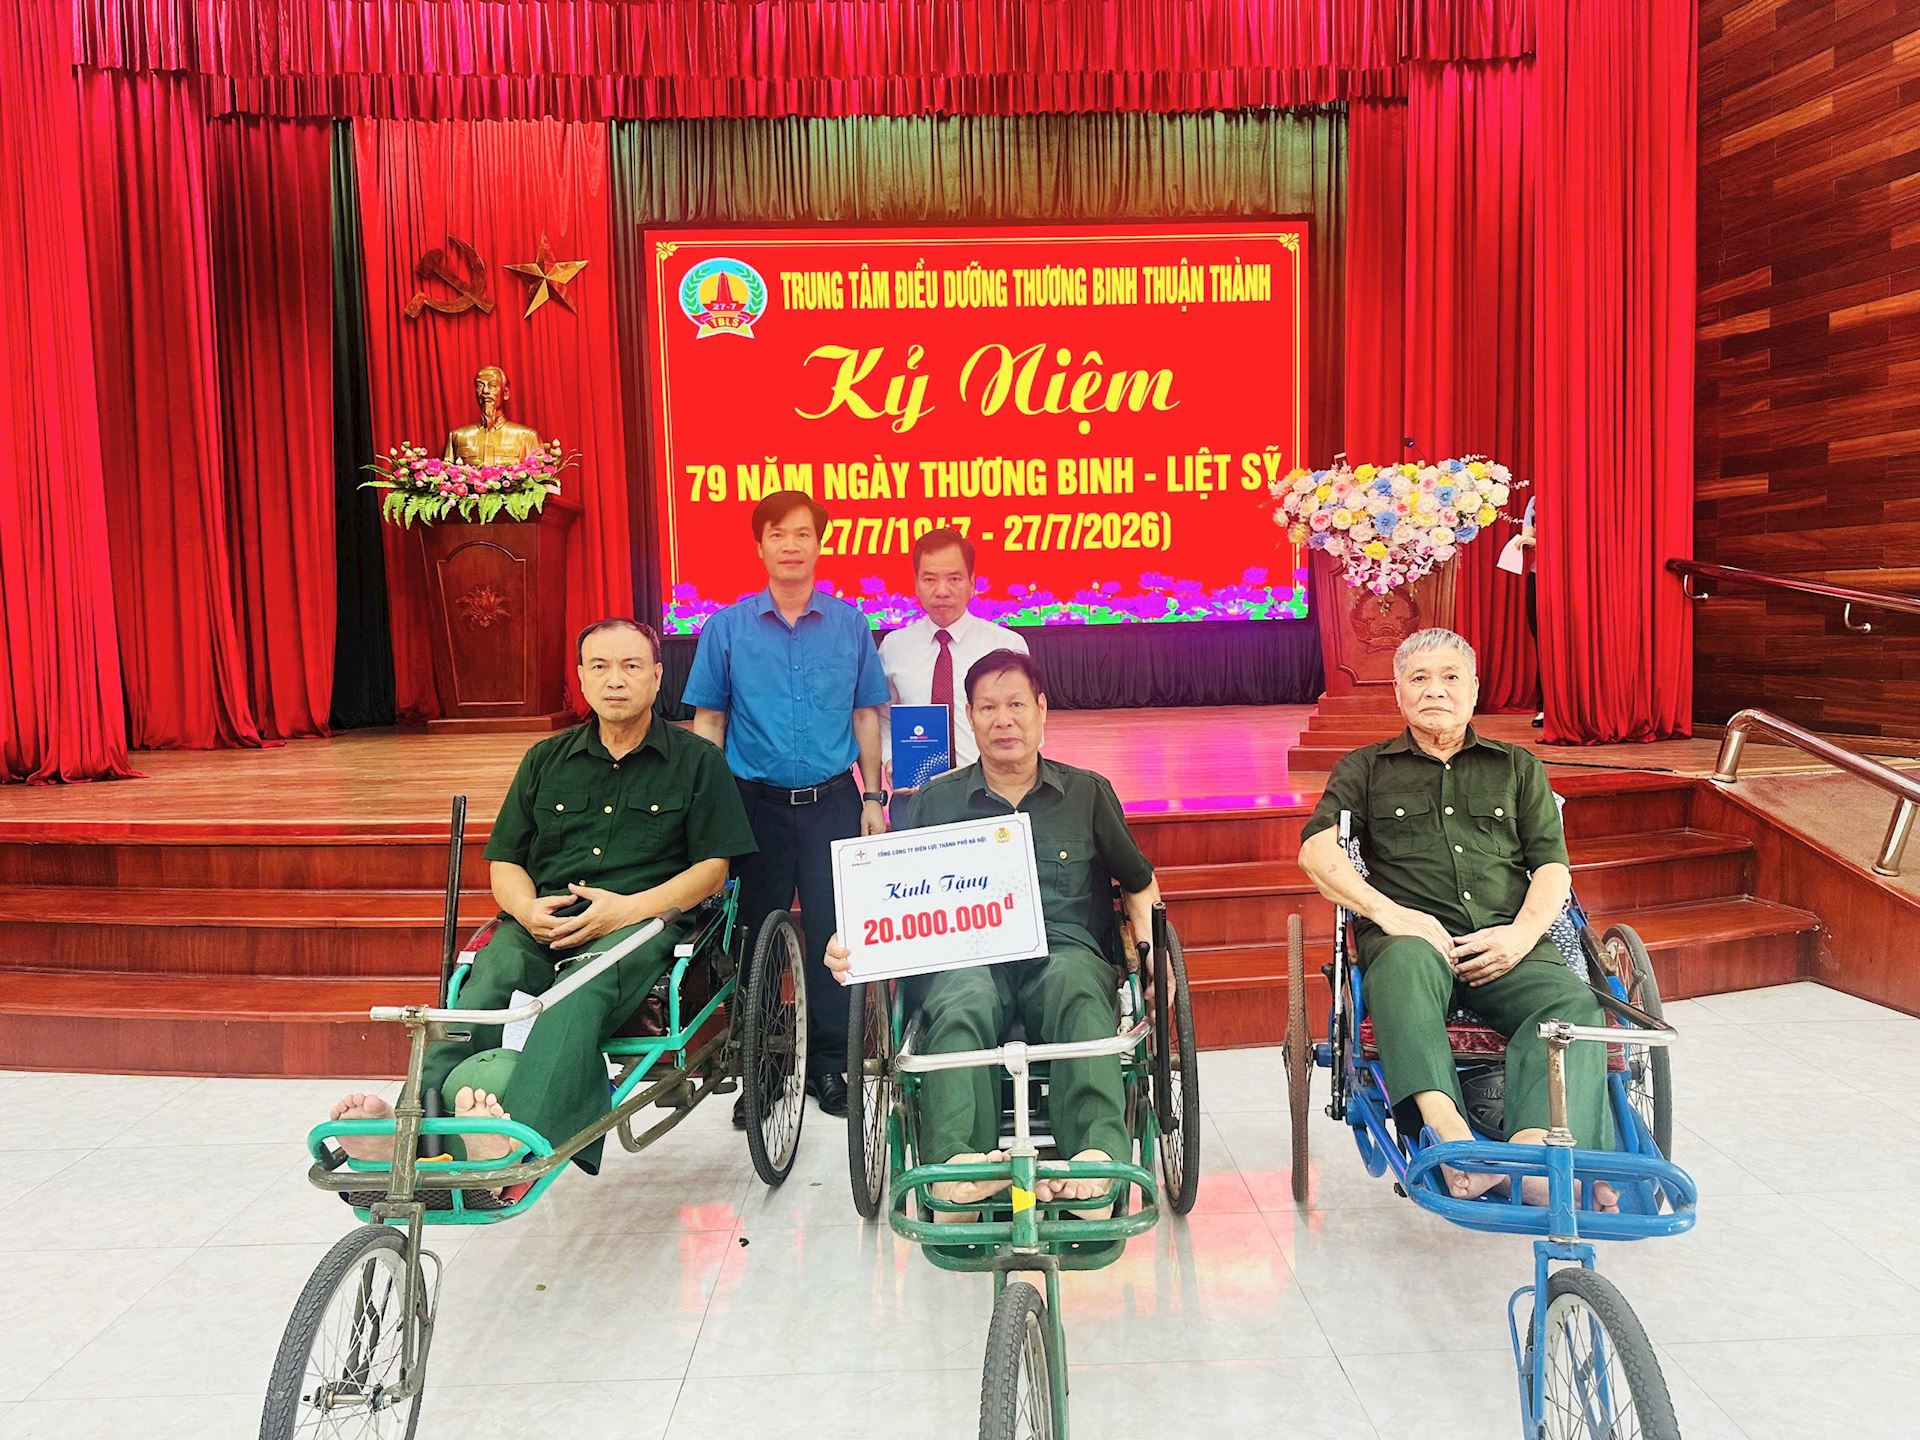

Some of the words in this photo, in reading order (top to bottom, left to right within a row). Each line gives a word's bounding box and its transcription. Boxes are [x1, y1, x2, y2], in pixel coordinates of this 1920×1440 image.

[712, 303, 738, 311] 27-7
[780, 270, 845, 311] TRUNG
[848, 264, 890, 309] TÂM
[895, 258, 939, 310] ĐIỀU
[943, 260, 1008, 309] DƯỠNG
[1012, 264, 1088, 308] THƯƠNG
[1092, 266, 1138, 306] BINH
[1142, 258, 1204, 312] THUẬN
[1208, 256, 1271, 304] THÀNH
[710, 317, 740, 327] TBLS
[794, 343, 936, 434] Kỷ
[959, 342, 1182, 435] Niệm
[685, 464, 727, 502] 79
[736, 455, 814, 502] NĂM
[823, 454, 910, 501] NGÀY
[919, 455, 1047, 499] THƯƠNG
[1057, 456, 1134, 497] BINH
[1144, 473, 1157, 482] -
[1166, 446, 1232, 500] LIỆT
[1240, 444, 1283, 491] SỸ
[981, 531, 994, 541] -
[1003, 511, 1172, 552] 27/7/2026)
